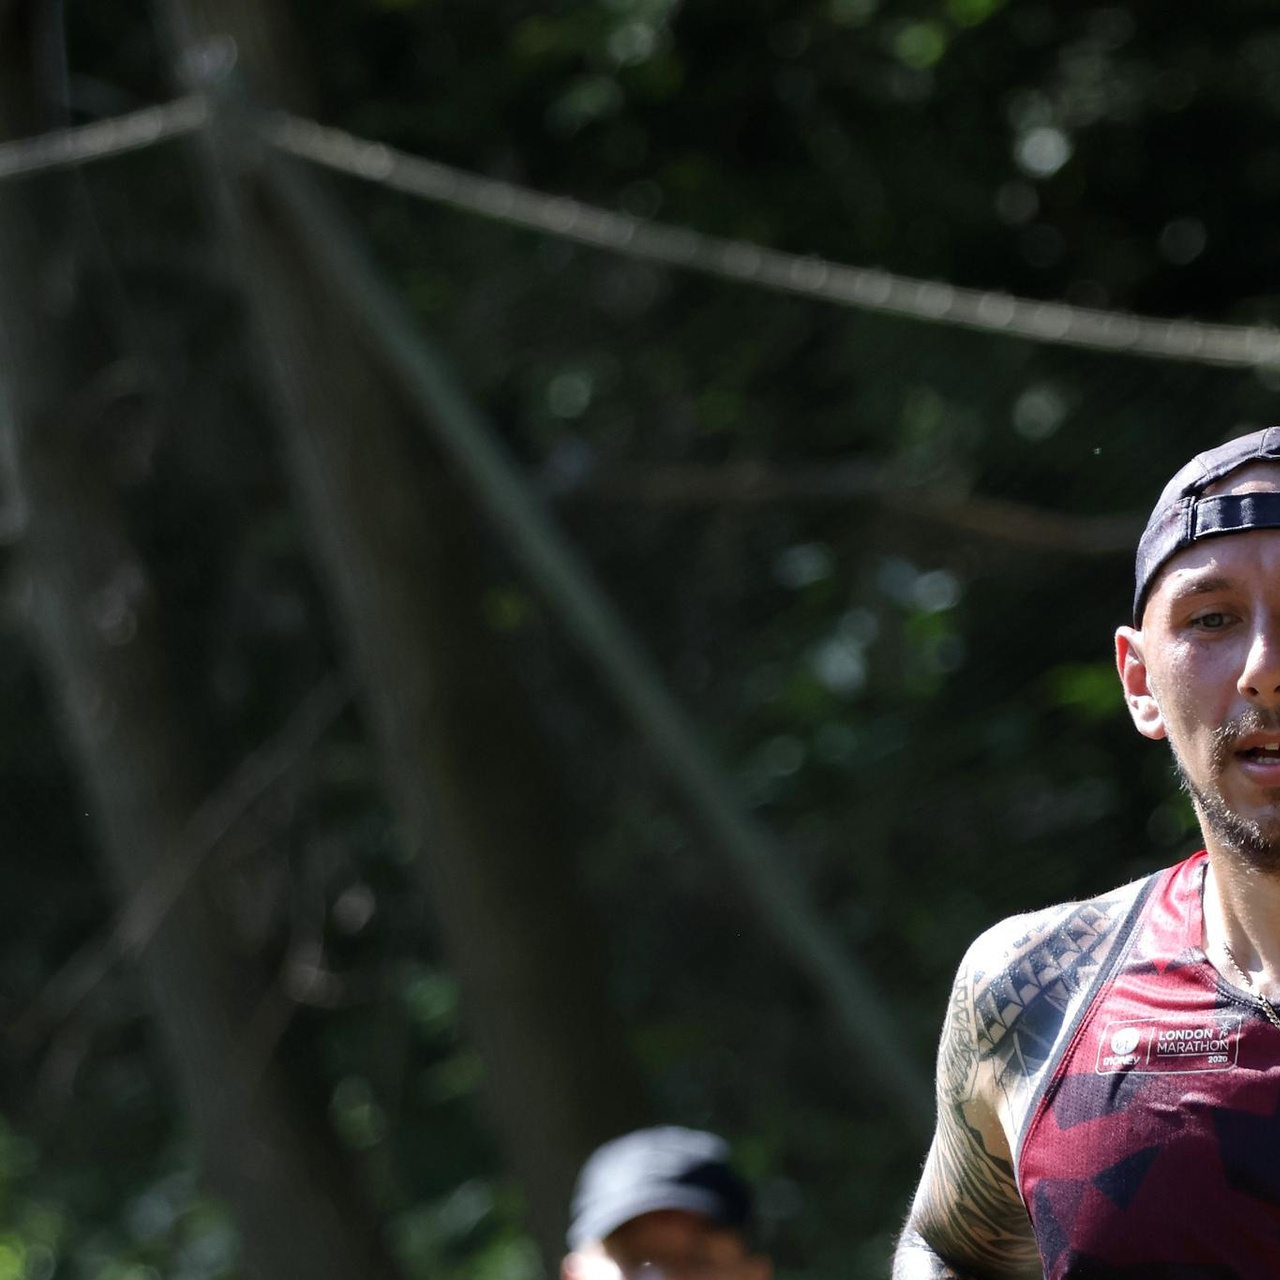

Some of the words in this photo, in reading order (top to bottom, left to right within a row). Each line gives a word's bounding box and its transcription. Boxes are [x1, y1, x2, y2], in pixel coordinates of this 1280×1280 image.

[1158, 1029, 1213, 1040] LONDON
[1157, 1040, 1230, 1053] MARATHON
[1208, 1055, 1228, 1064] 2020
